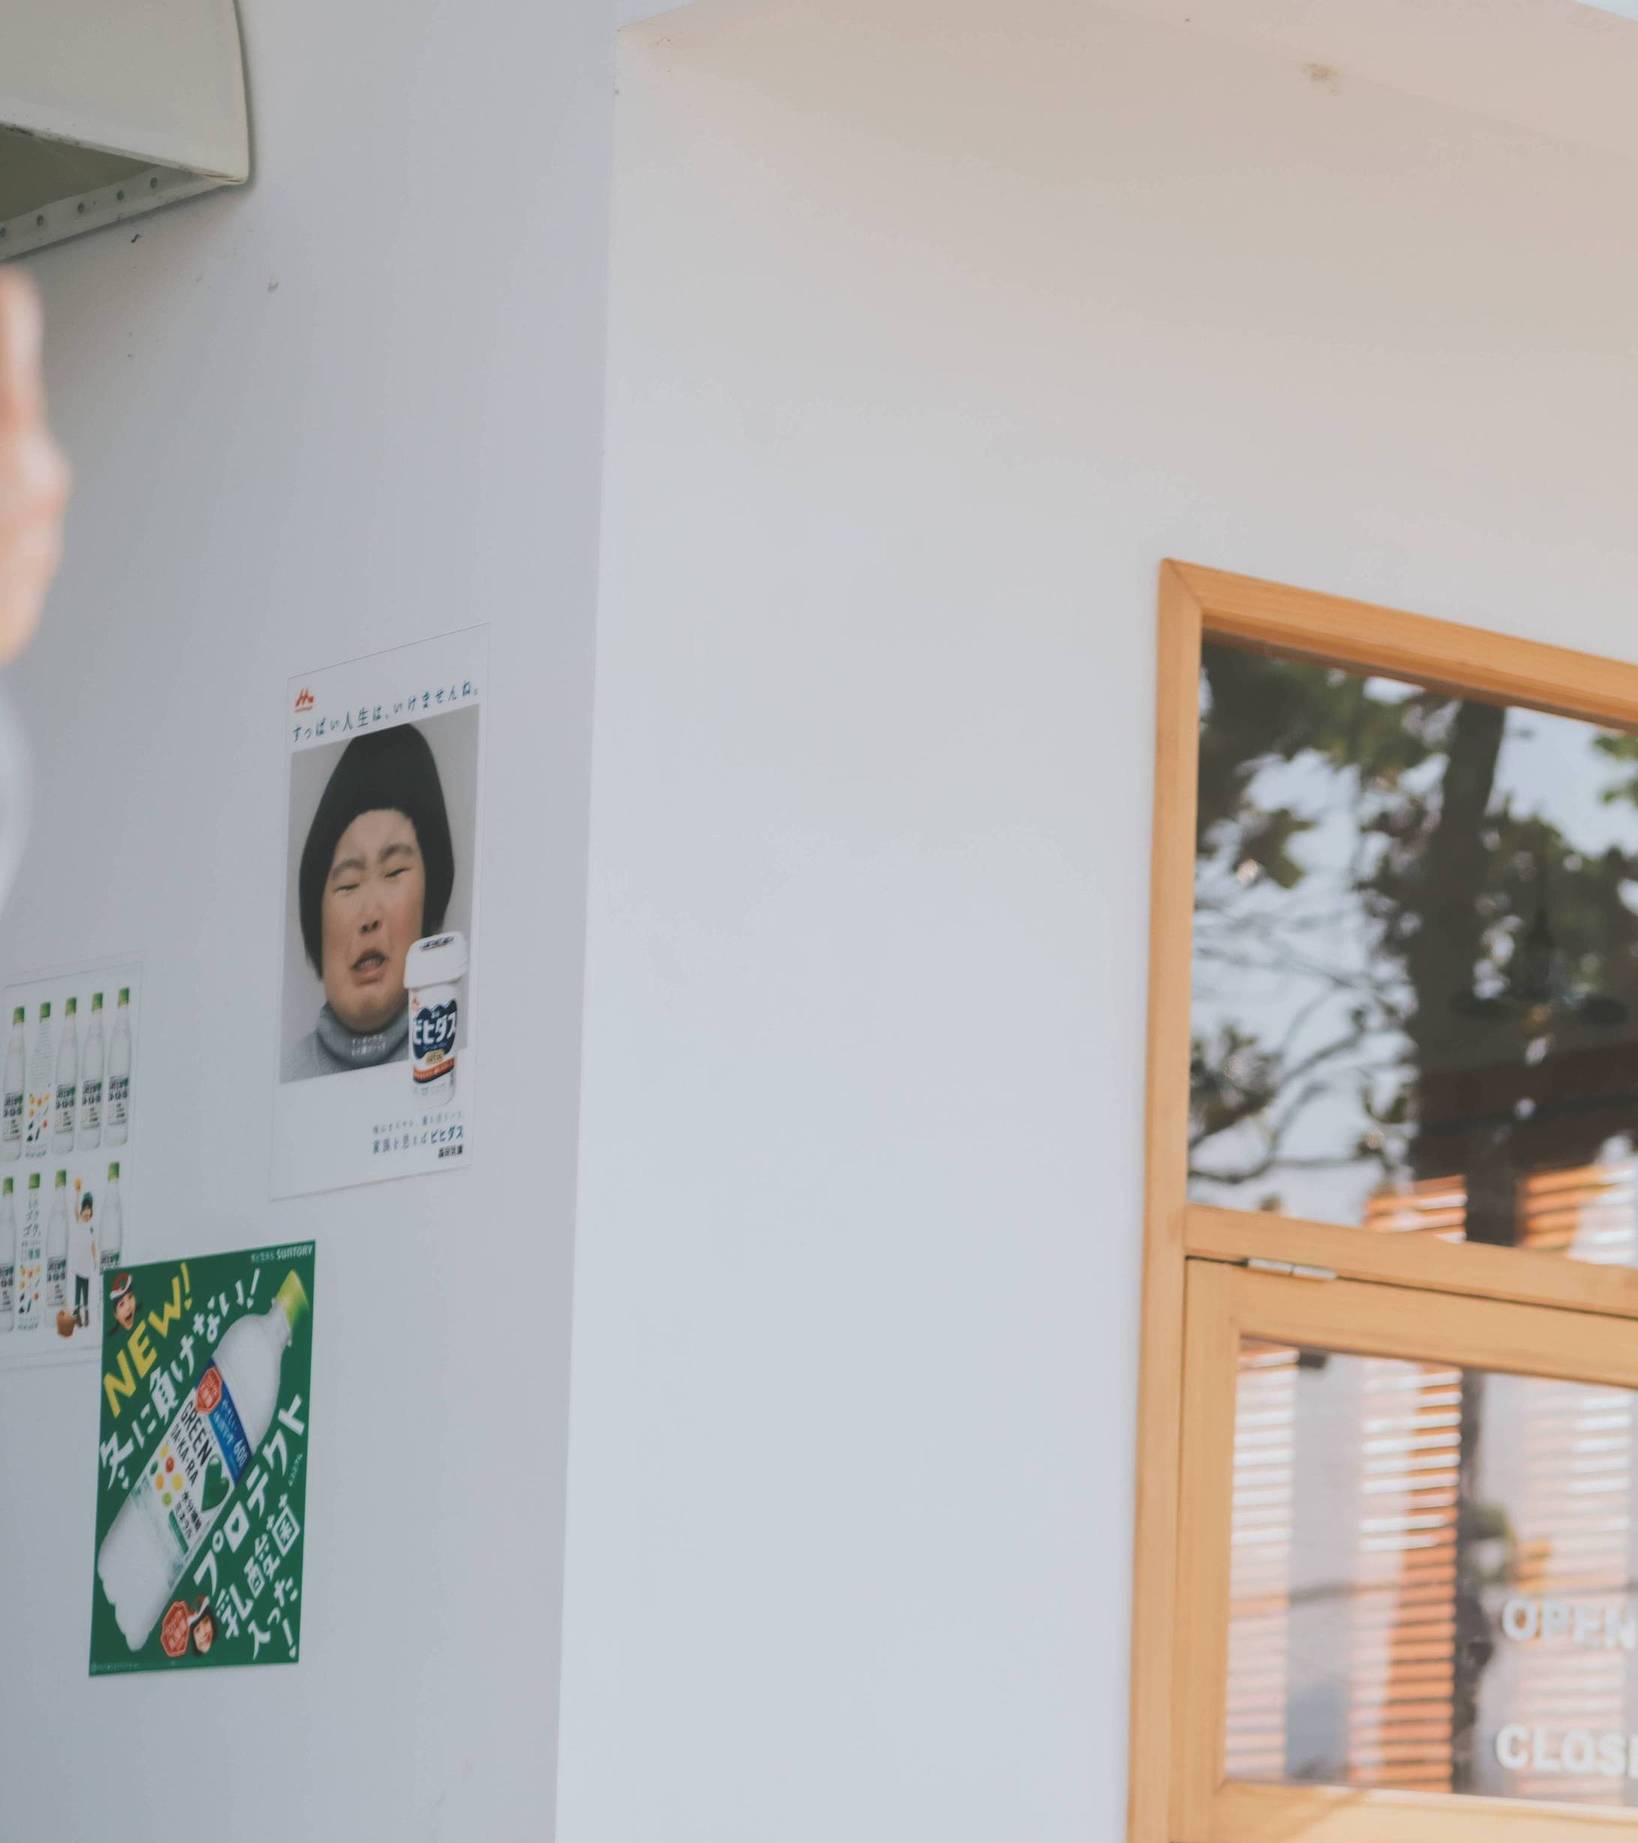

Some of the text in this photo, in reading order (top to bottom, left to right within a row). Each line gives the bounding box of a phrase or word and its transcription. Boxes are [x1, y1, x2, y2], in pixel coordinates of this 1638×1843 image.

[413, 1012, 456, 1045] ビヒダス
[276, 1244, 313, 1261] SUNTORY
[103, 1262, 193, 1419] NEW!
[180, 1401, 213, 1467] GREEN
[194, 1394, 305, 1597] プロテクト
[216, 1493, 300, 1640] 乳酸菌
[1502, 1599, 1638, 1650] OPEN
